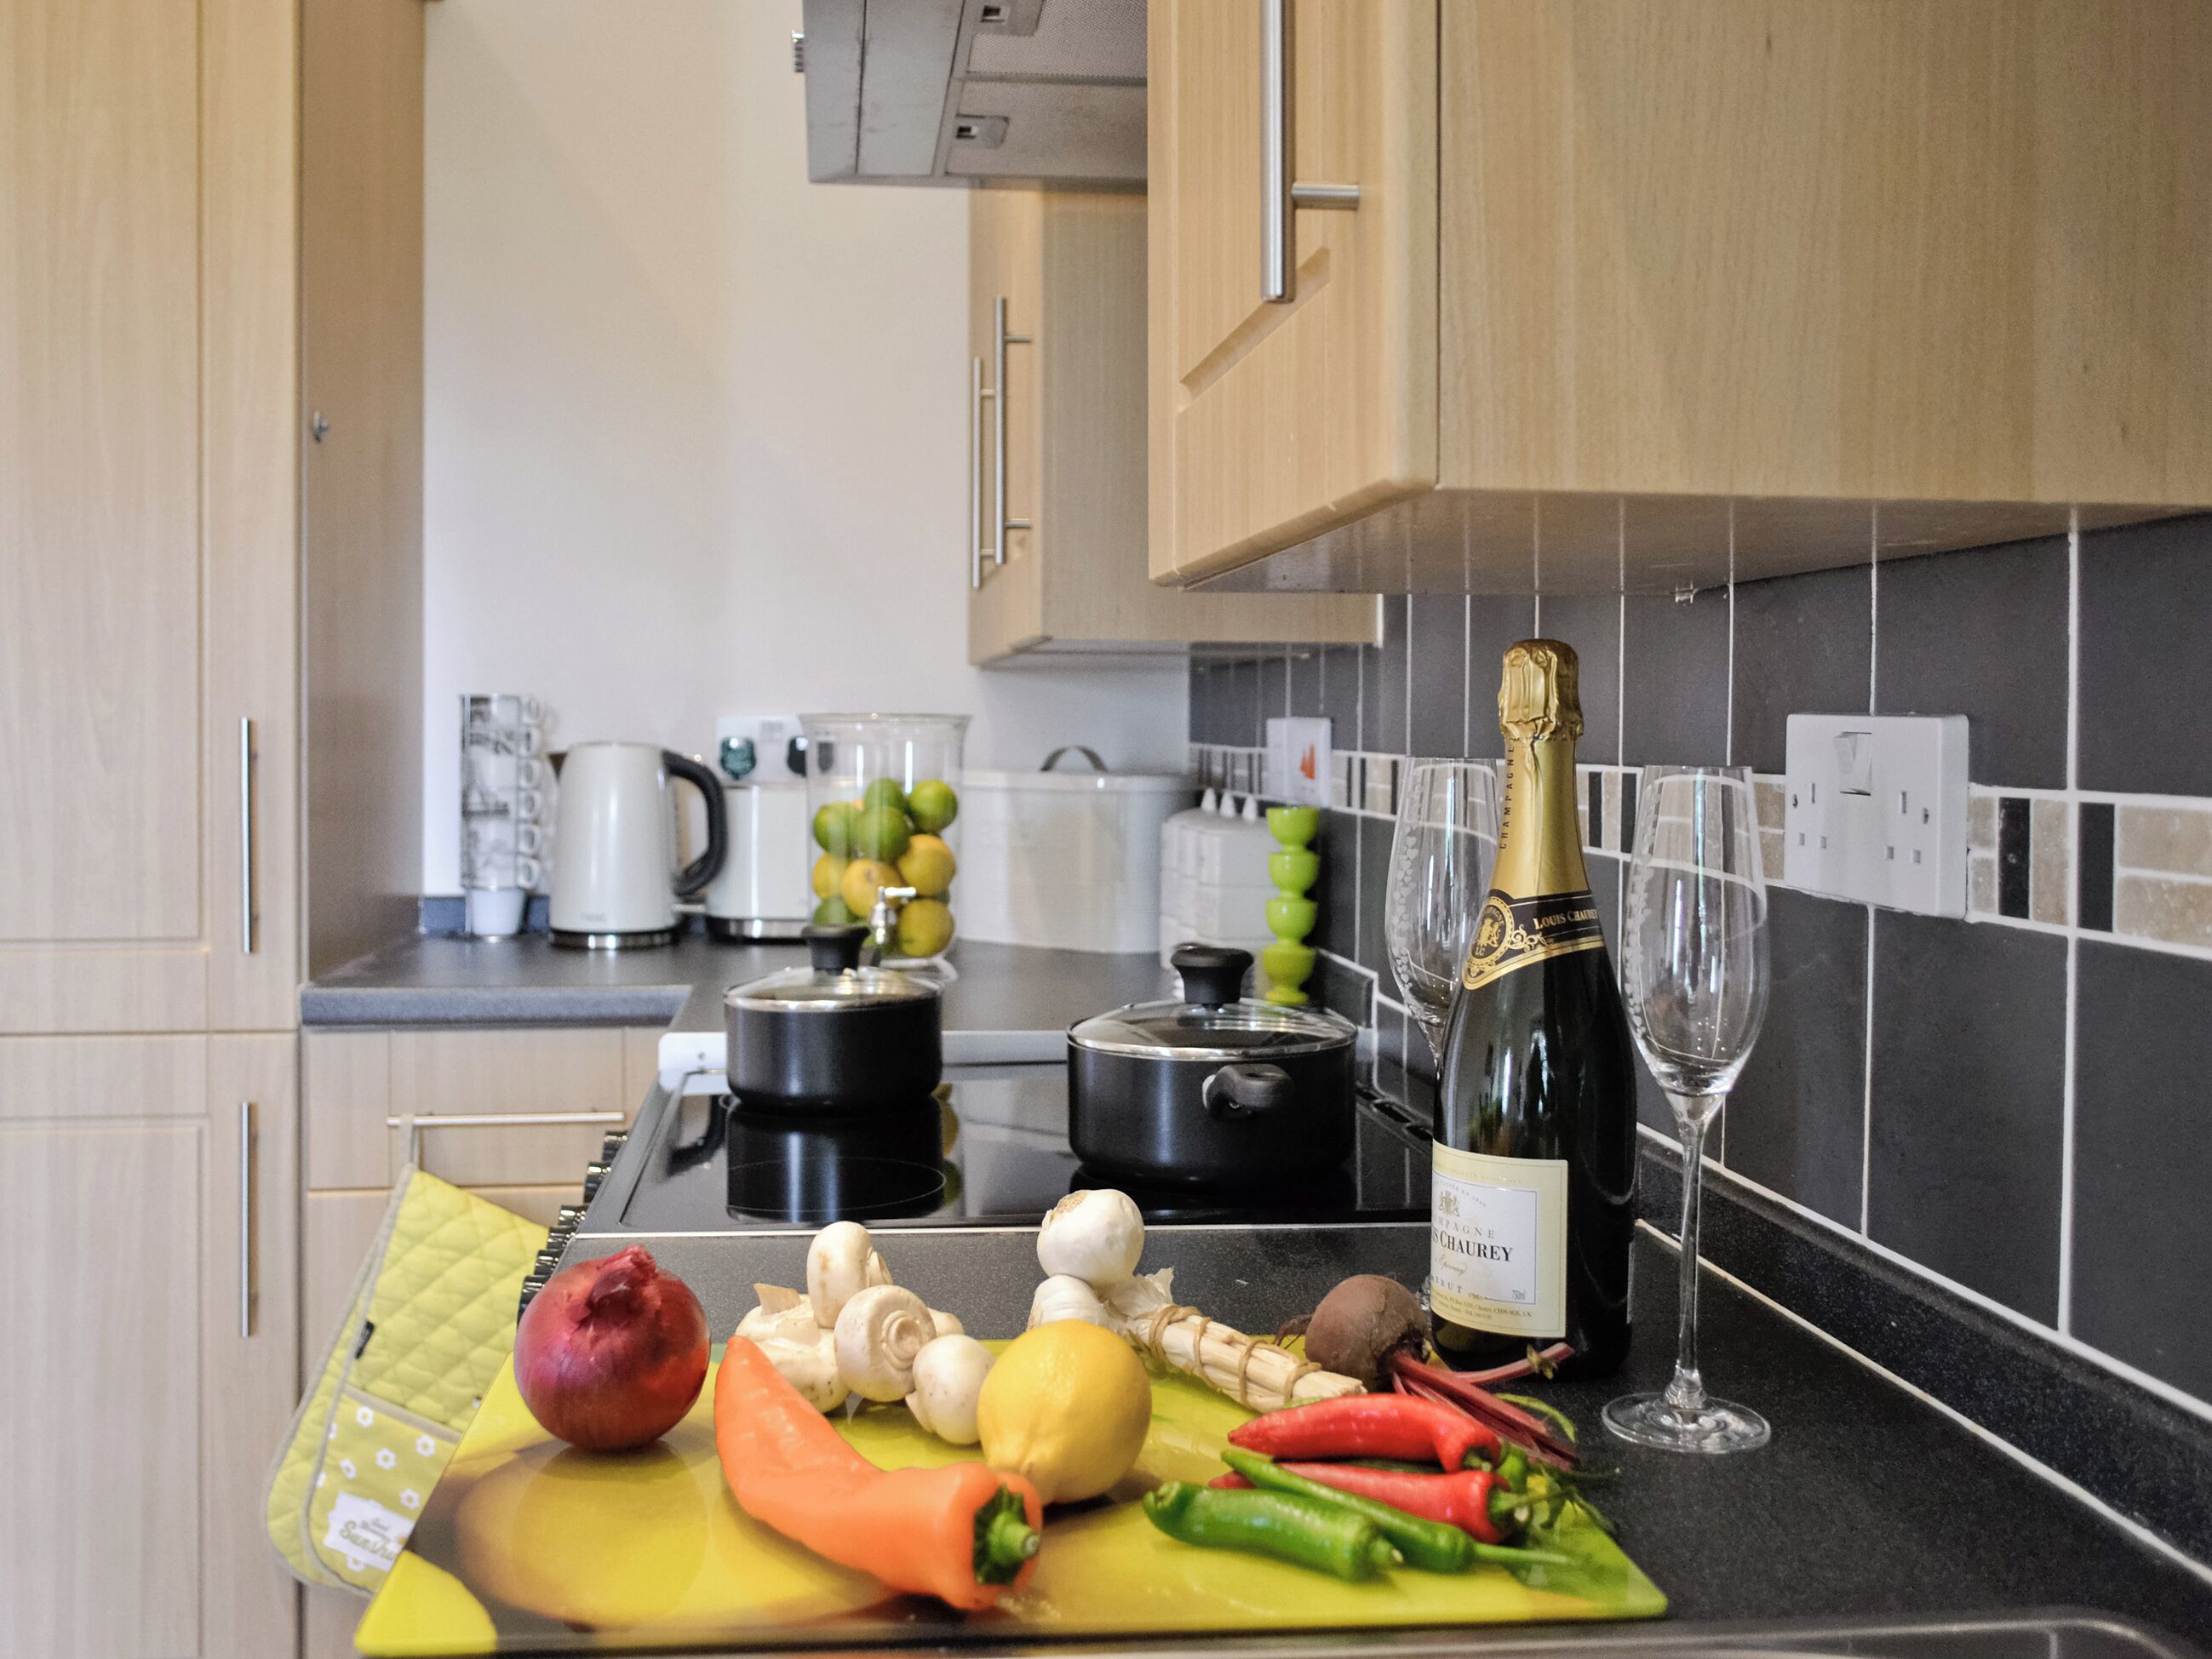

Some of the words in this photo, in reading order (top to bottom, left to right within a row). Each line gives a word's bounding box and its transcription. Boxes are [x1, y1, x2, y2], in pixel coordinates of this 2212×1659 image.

[1533, 912, 1567, 930] LOUIS
[1434, 1213, 1496, 1239] MPAGNE
[1440, 1230, 1514, 1262] CHAUREY
